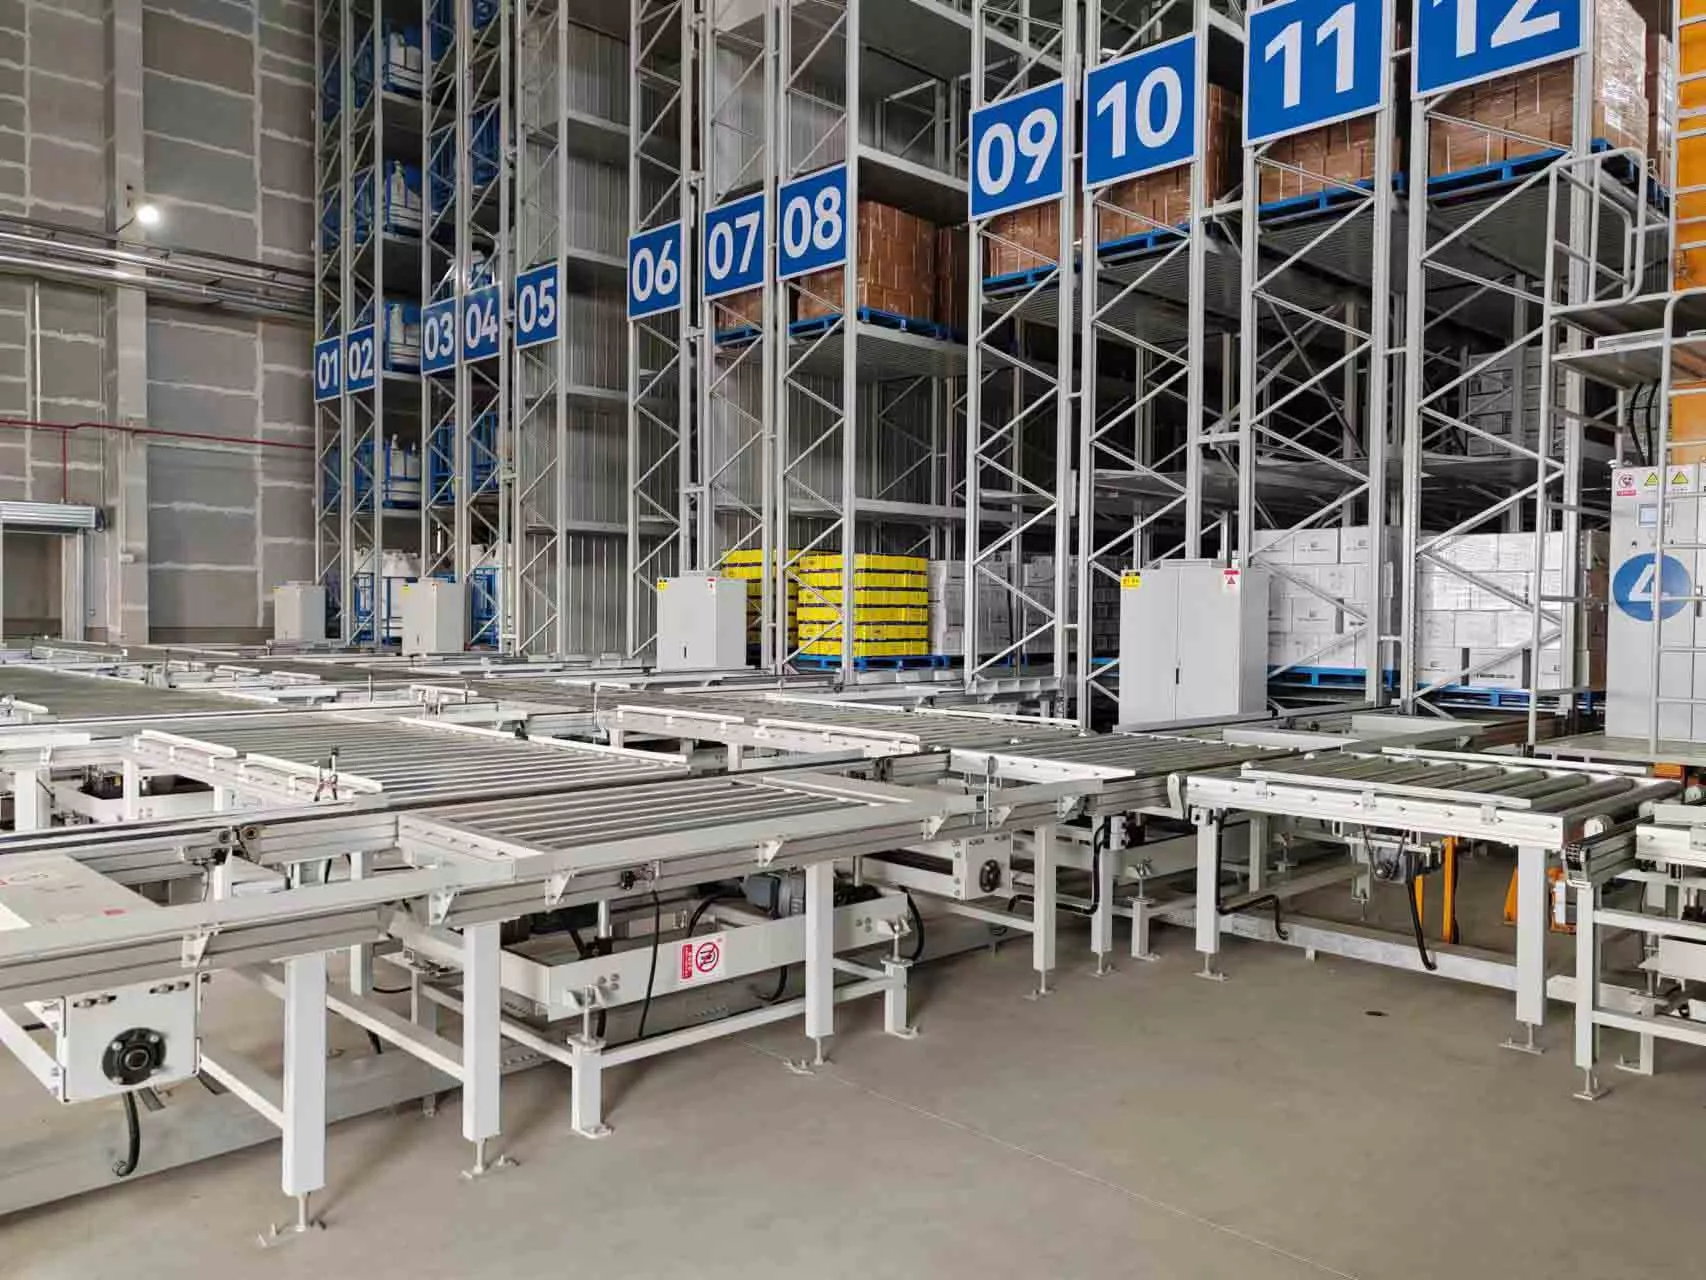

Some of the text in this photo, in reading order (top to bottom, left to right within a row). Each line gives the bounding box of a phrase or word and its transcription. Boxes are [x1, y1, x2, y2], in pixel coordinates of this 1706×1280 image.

[1265, 3, 1356, 109] 11
[1097, 66, 1182, 158] 10
[977, 108, 1058, 195] 09
[708, 211, 760, 280] 07
[783, 186, 842, 258] 08
[632, 239, 678, 302] 06
[424, 311, 454, 361] 03
[465, 298, 498, 349] 04
[518, 277, 555, 333] 05
[318, 348, 338, 390] 01
[348, 338, 374, 381] 02
